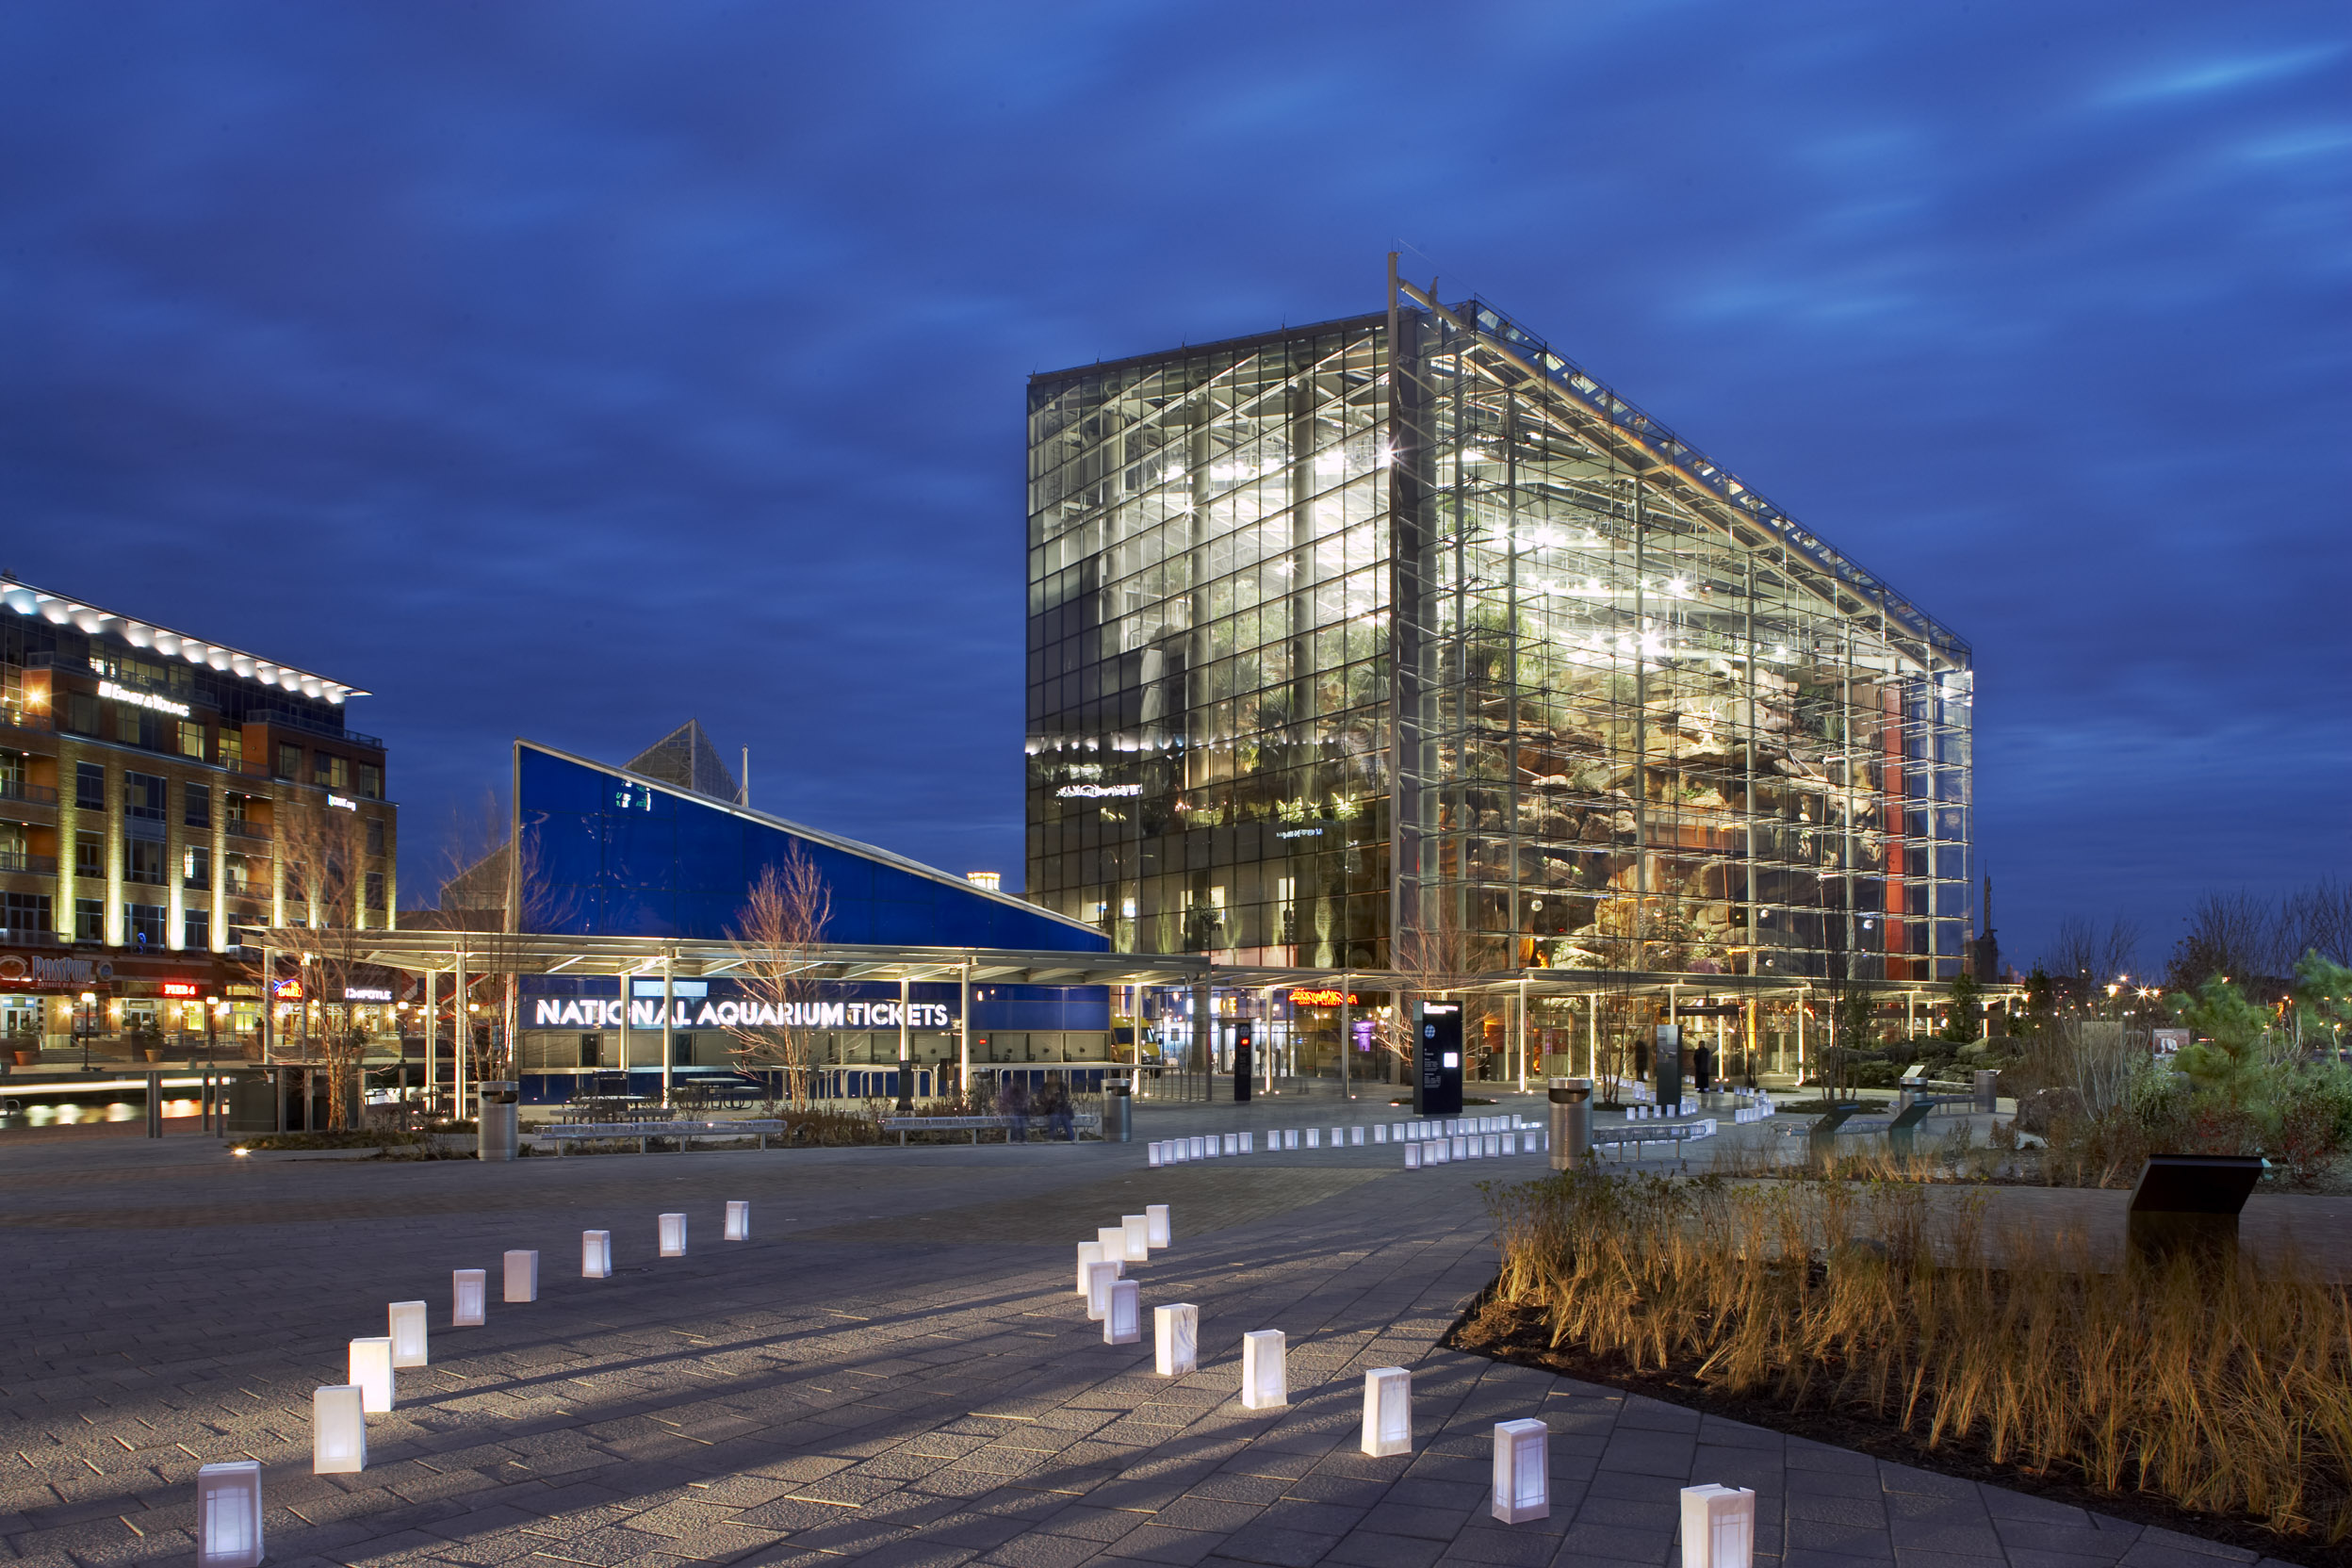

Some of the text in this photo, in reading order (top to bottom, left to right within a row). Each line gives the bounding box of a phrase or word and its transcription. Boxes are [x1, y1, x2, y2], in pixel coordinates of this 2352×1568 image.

[144, 695, 154, 708] &
[153, 694, 189, 716] YOUNG
[164, 984, 196, 995] PIER 4
[536, 999, 948, 1026] NATIONAL AQUARIUM TICKETS
